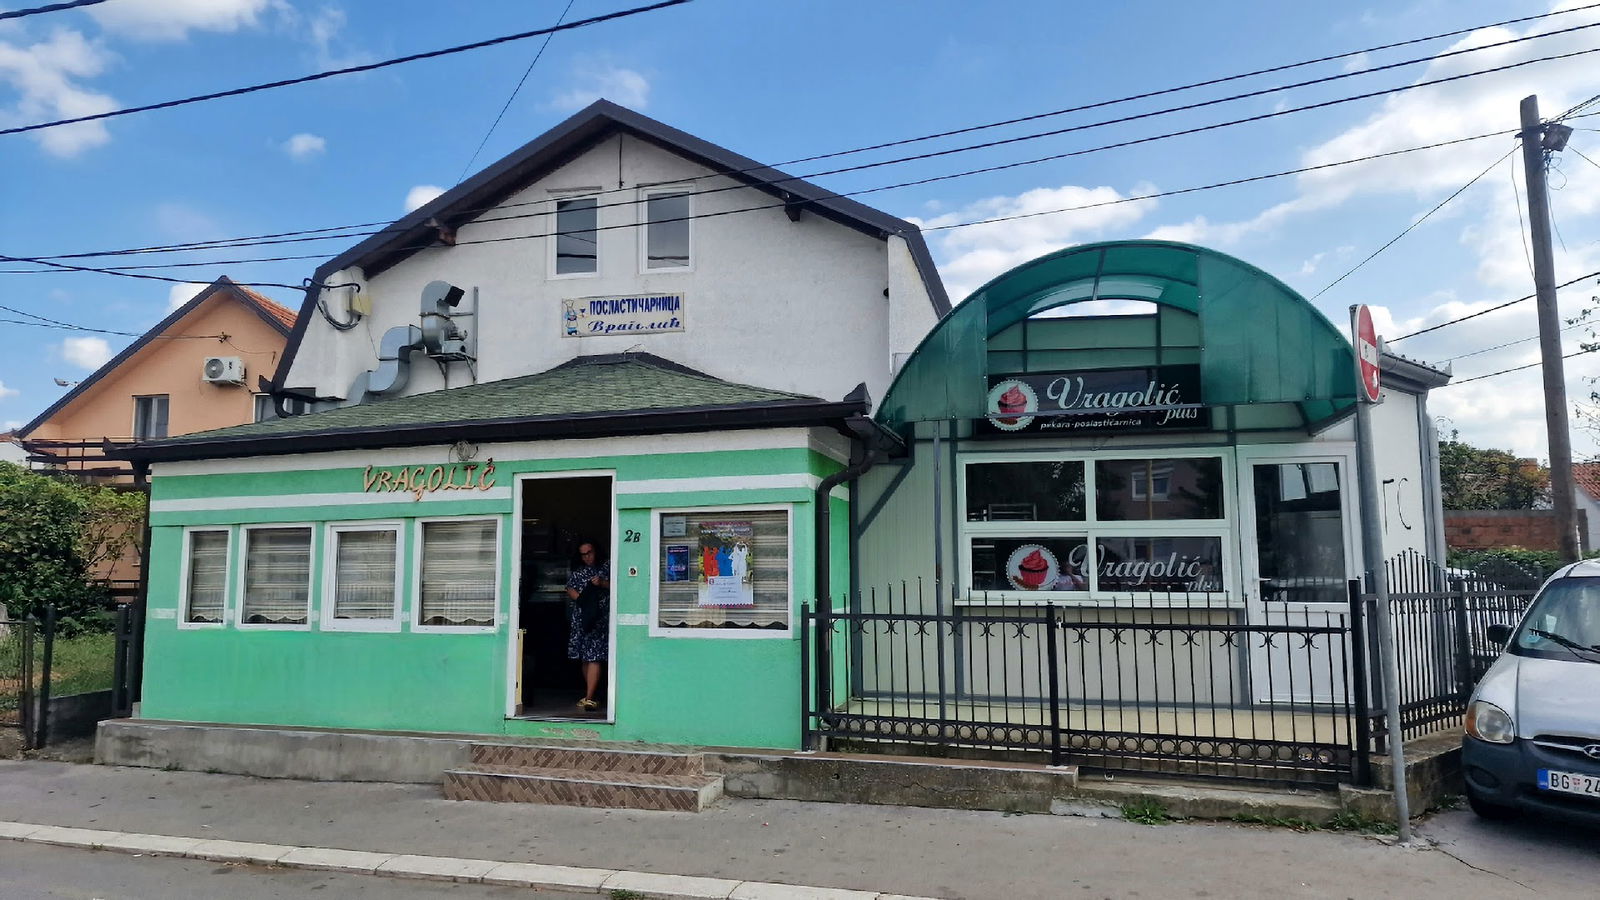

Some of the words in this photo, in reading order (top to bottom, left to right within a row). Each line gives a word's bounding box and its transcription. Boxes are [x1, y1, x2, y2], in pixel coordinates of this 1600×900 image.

[589, 296, 680, 315] ПОСЛАСТИЧАРНИЦА
[1046, 376, 1181, 415] Vragolić
[363, 457, 496, 502] VRAGOLIĆ
[623, 529, 641, 543] 2B
[1068, 543, 1202, 587] Vragolić
[1551, 772, 1570, 790] BG
